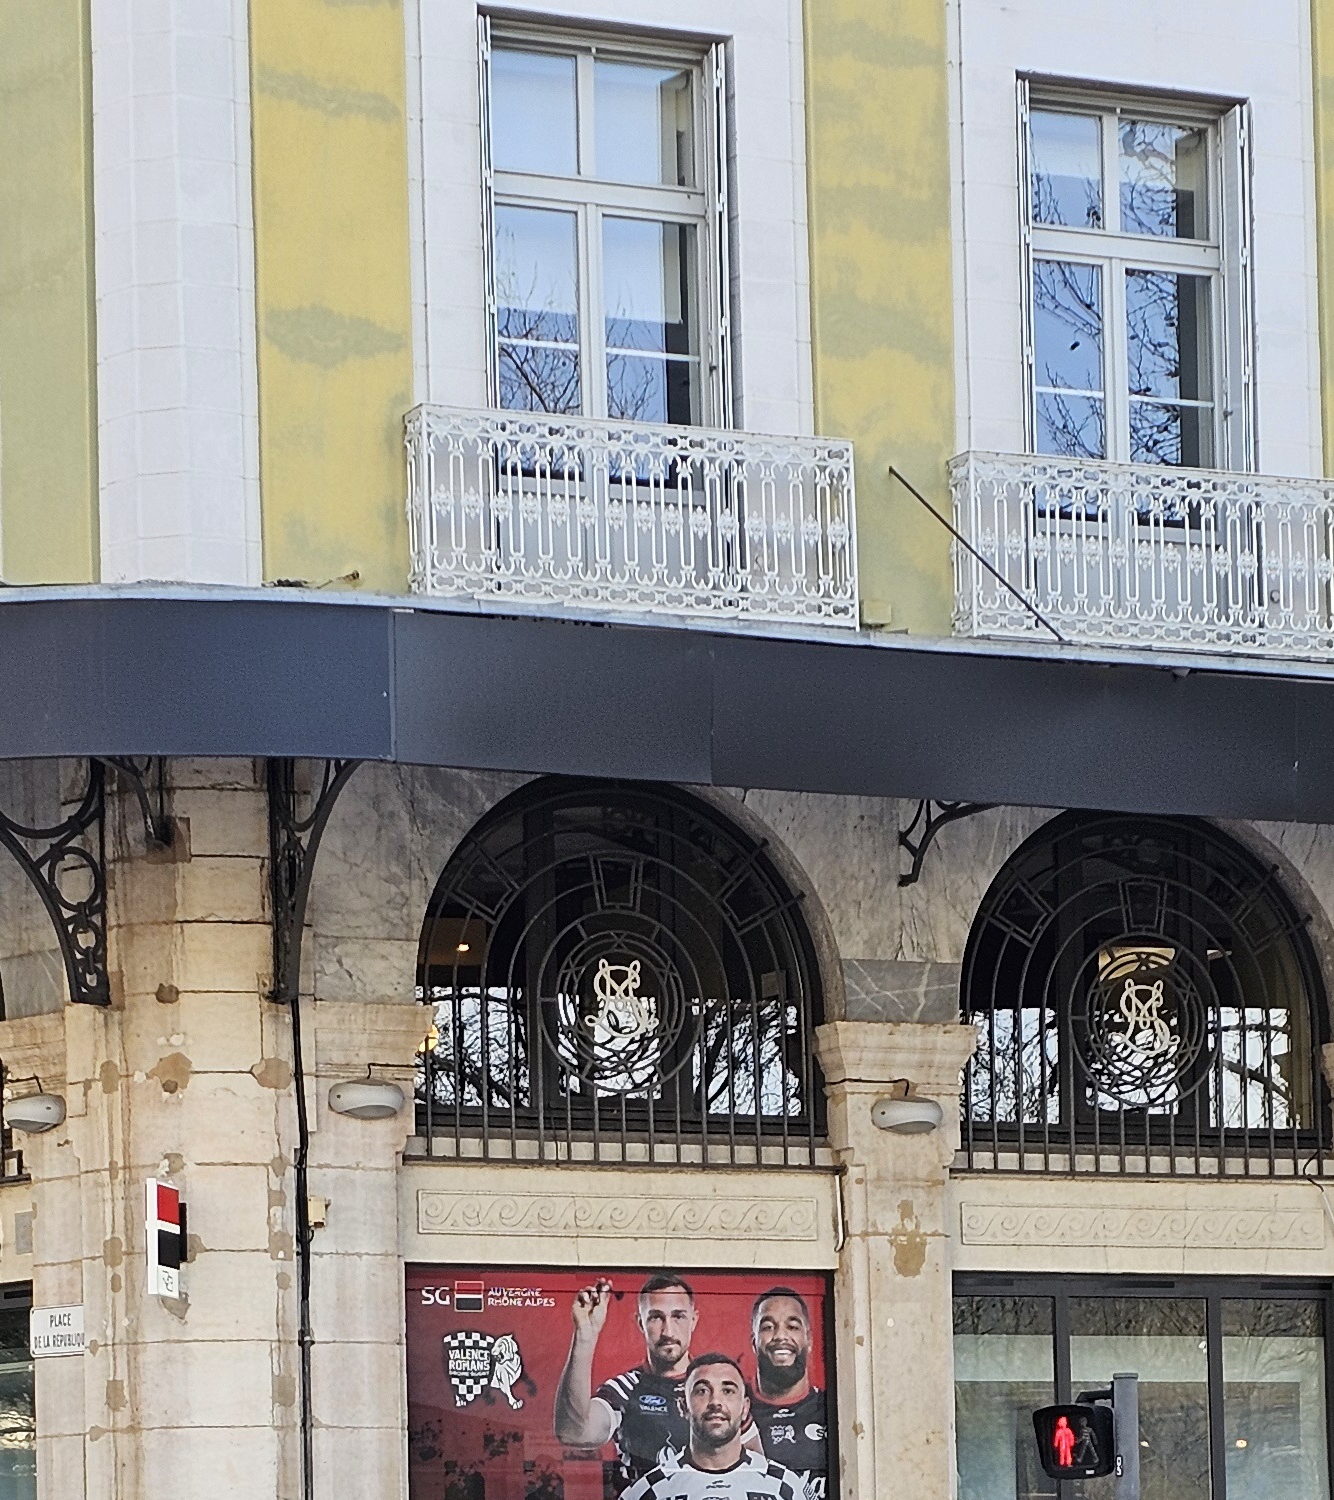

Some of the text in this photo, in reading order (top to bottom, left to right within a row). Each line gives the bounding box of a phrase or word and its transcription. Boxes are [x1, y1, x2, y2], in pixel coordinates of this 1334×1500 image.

[421, 1286, 451, 1306] SG
[487, 1287, 543, 1297] AUVERGNE
[525, 1298, 556, 1307] ALPES
[49, 1312, 72, 1328] PLACE
[34, 1332, 85, 1350] DE LA RÉPUBLIQU
